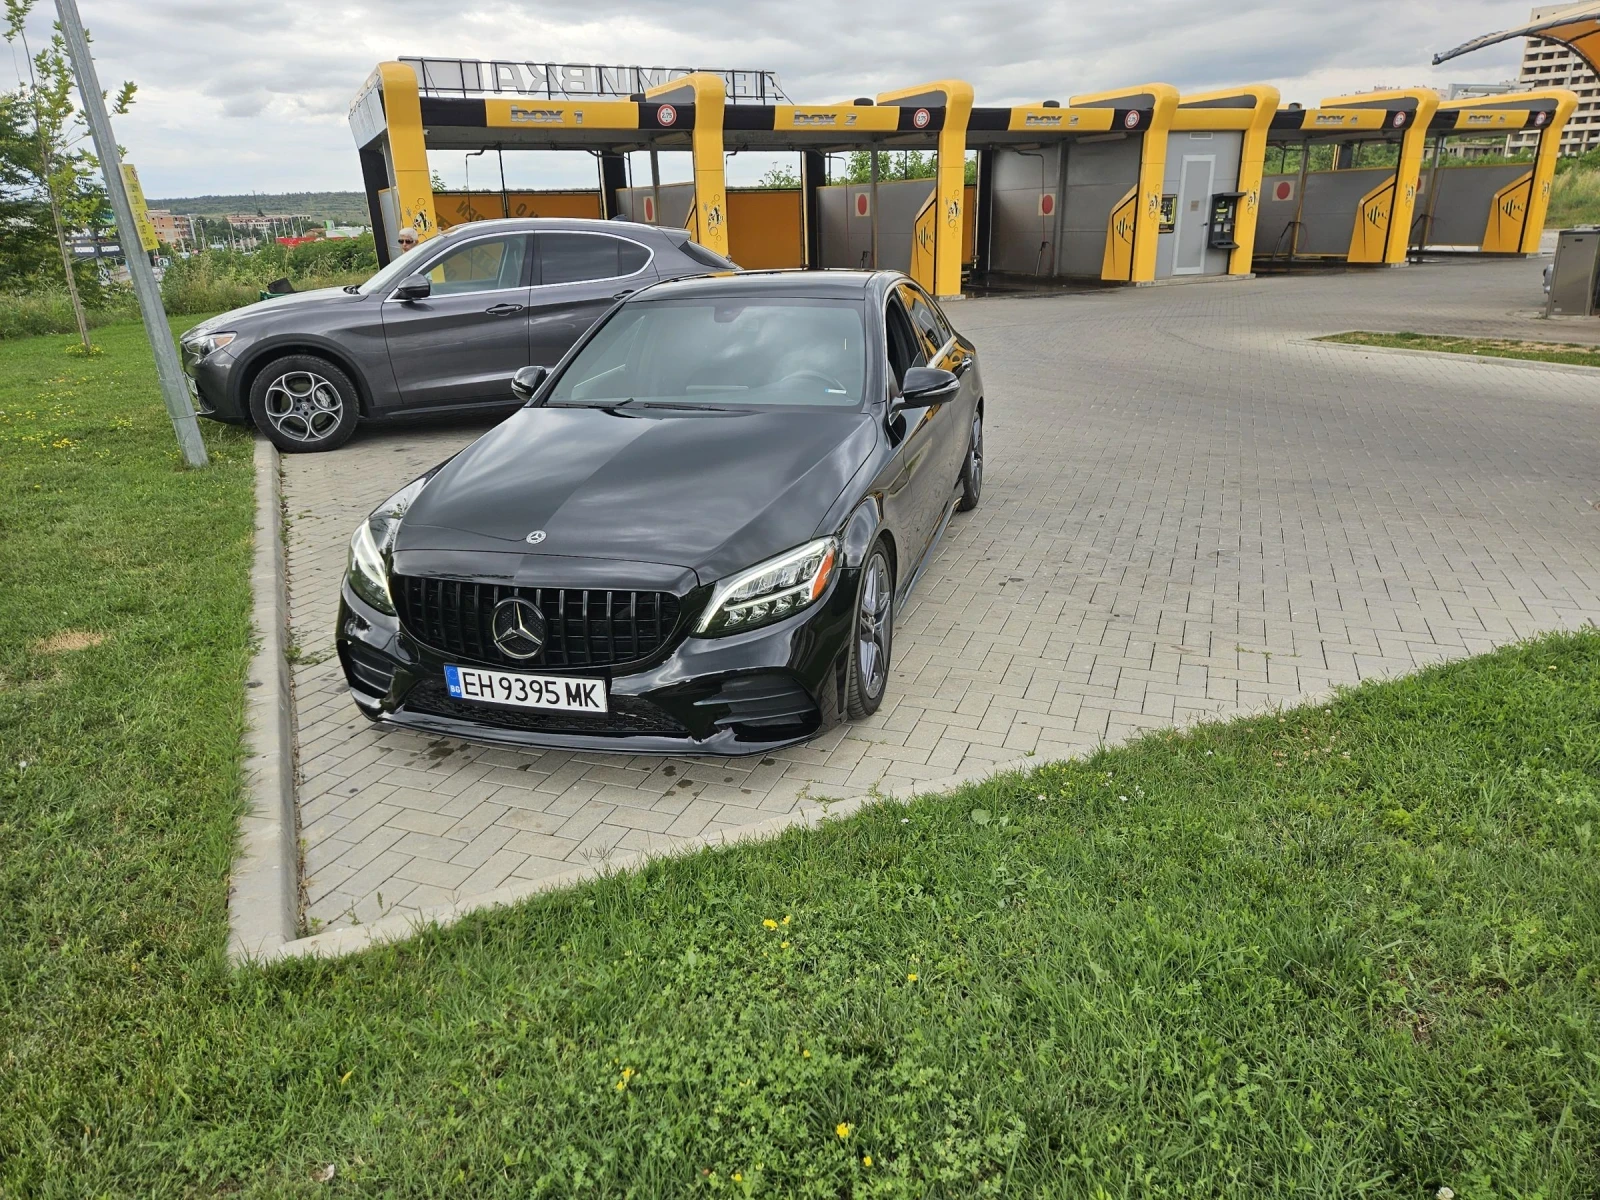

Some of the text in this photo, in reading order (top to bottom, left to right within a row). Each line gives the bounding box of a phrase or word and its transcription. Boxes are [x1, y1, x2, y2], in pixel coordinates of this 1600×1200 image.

[510, 105, 584, 124] box 1
[793, 110, 857, 126] box 2
[1026, 112, 1062, 126] box
[450, 685, 461, 694] BG
[565, 682, 600, 708] MK
